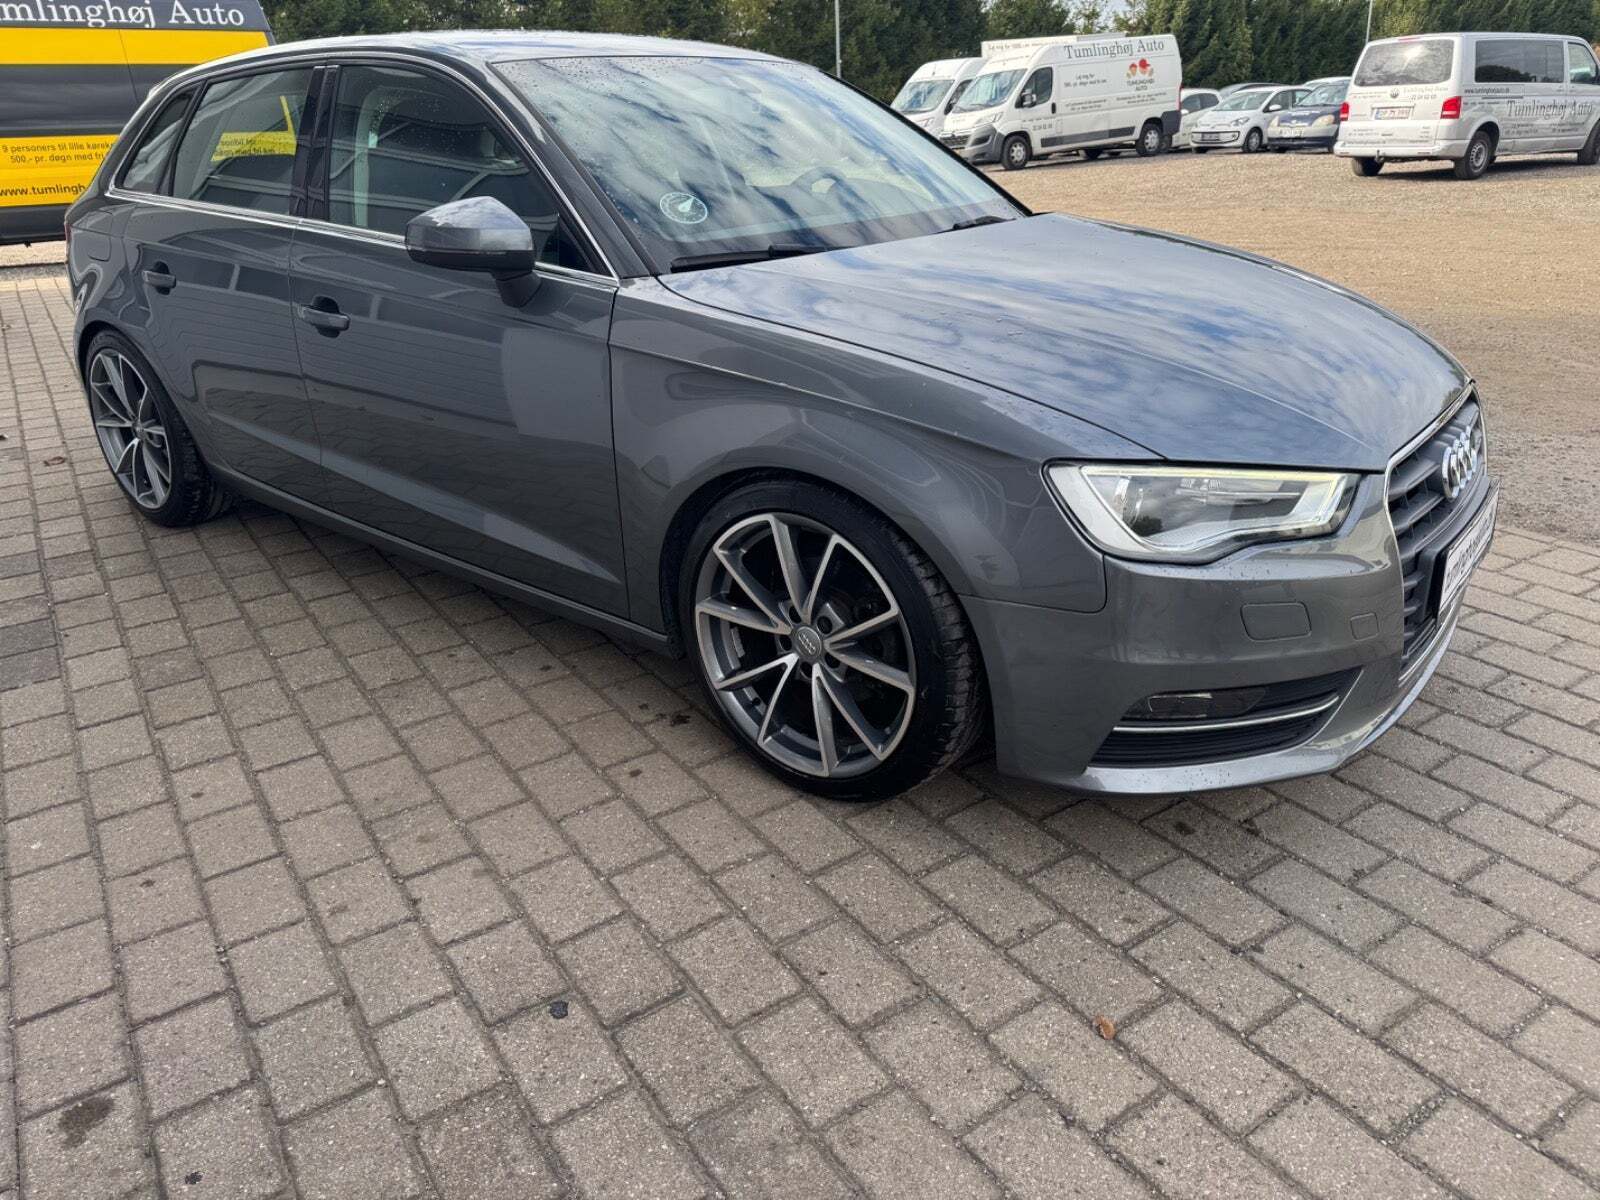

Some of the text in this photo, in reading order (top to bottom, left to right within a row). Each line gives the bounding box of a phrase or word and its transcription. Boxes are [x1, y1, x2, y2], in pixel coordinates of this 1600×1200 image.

[0, 0, 245, 28] mlinghøj Auto
[1064, 39, 1164, 59] Tumlinghøj Auto
[1570, 100, 1593, 115] Auto
[69, 142, 84, 150] lille
[87, 142, 112, 150] kørek
[0, 184, 85, 196] www.tumlingh
